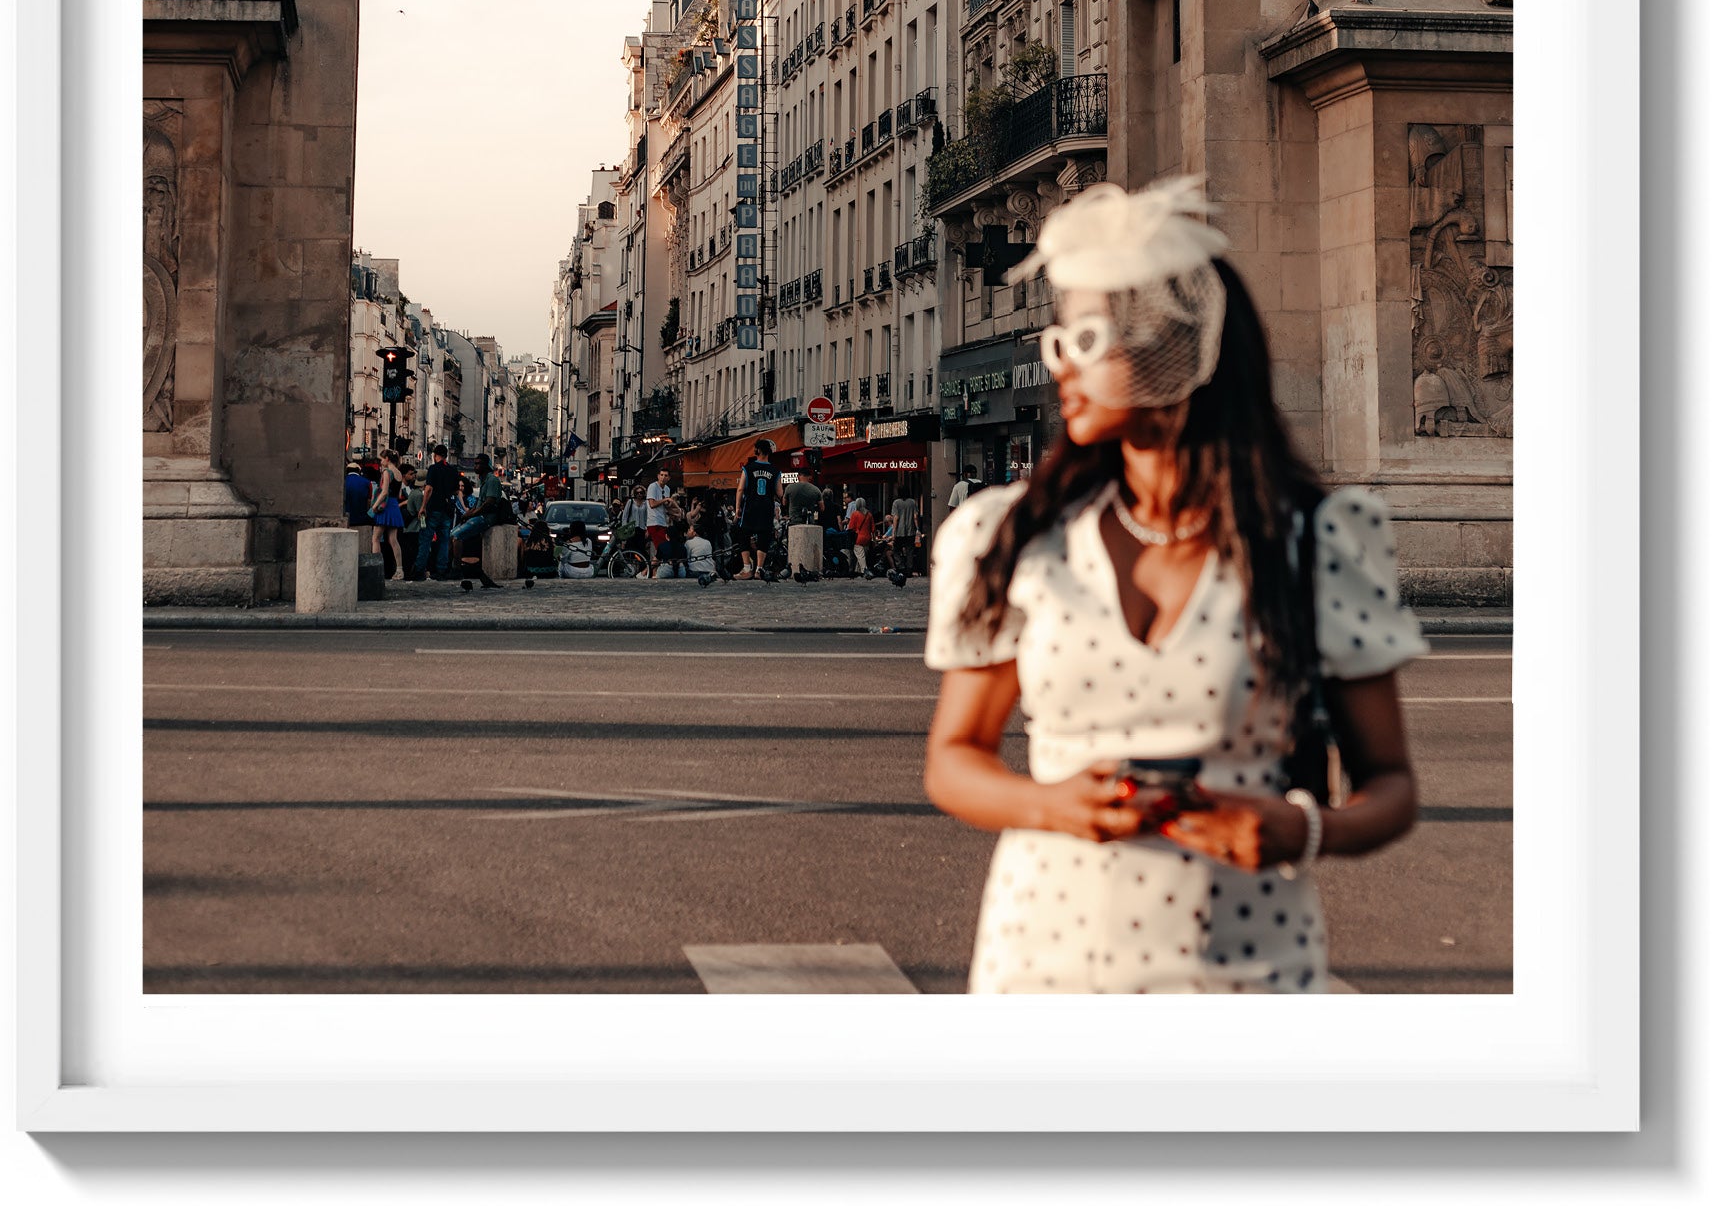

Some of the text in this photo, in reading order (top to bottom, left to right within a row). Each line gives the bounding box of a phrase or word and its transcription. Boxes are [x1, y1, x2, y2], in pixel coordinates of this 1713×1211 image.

[739, 180, 755, 191] DU
[741, 207, 754, 347] PRADO
[992, 371, 1005, 390] DENIS
[1013, 363, 1032, 390] OPTIC
[864, 460, 918, 469] l'Amour du Kebab
[752, 469, 774, 480] WILLIAMS
